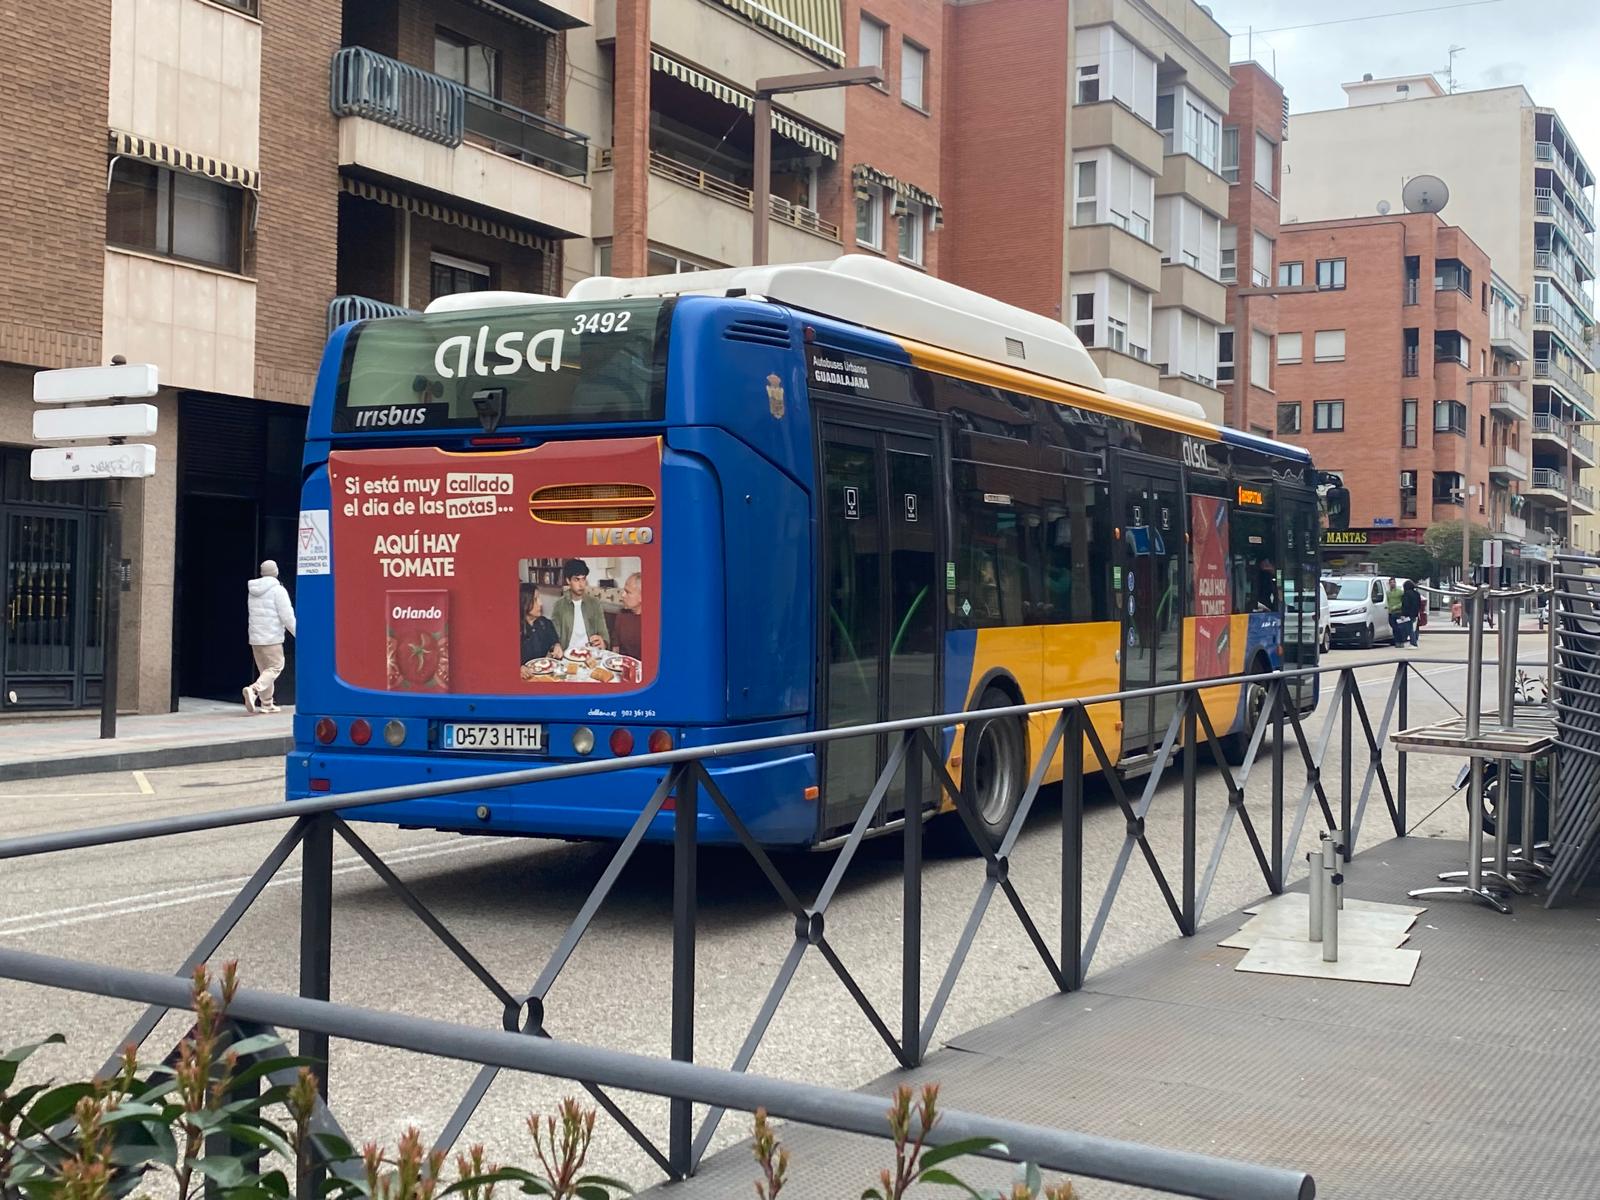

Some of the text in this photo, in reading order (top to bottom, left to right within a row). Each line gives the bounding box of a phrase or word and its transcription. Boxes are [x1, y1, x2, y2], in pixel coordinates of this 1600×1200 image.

[571, 311, 631, 335] 3492
[434, 325, 564, 377] alsa
[813, 355, 868, 375] Autobuses Urbanos
[815, 370, 869, 389] GUADALAJARA
[355, 406, 426, 427] irisbus
[1182, 437, 1208, 469] alsa
[345, 474, 509, 497] Si está muy callado
[343, 500, 358, 516] el
[393, 498, 416, 515] de
[419, 496, 444, 514] las
[373, 530, 460, 556] AQUÍ HAY
[586, 526, 654, 546] IVECO
[1326, 531, 1367, 544] MANTAS
[379, 558, 455, 578] TOMATE
[392, 606, 442, 619] Orlando
[1201, 599, 1226, 615] TOMATE
[456, 727, 537, 746] 0573 HTH
